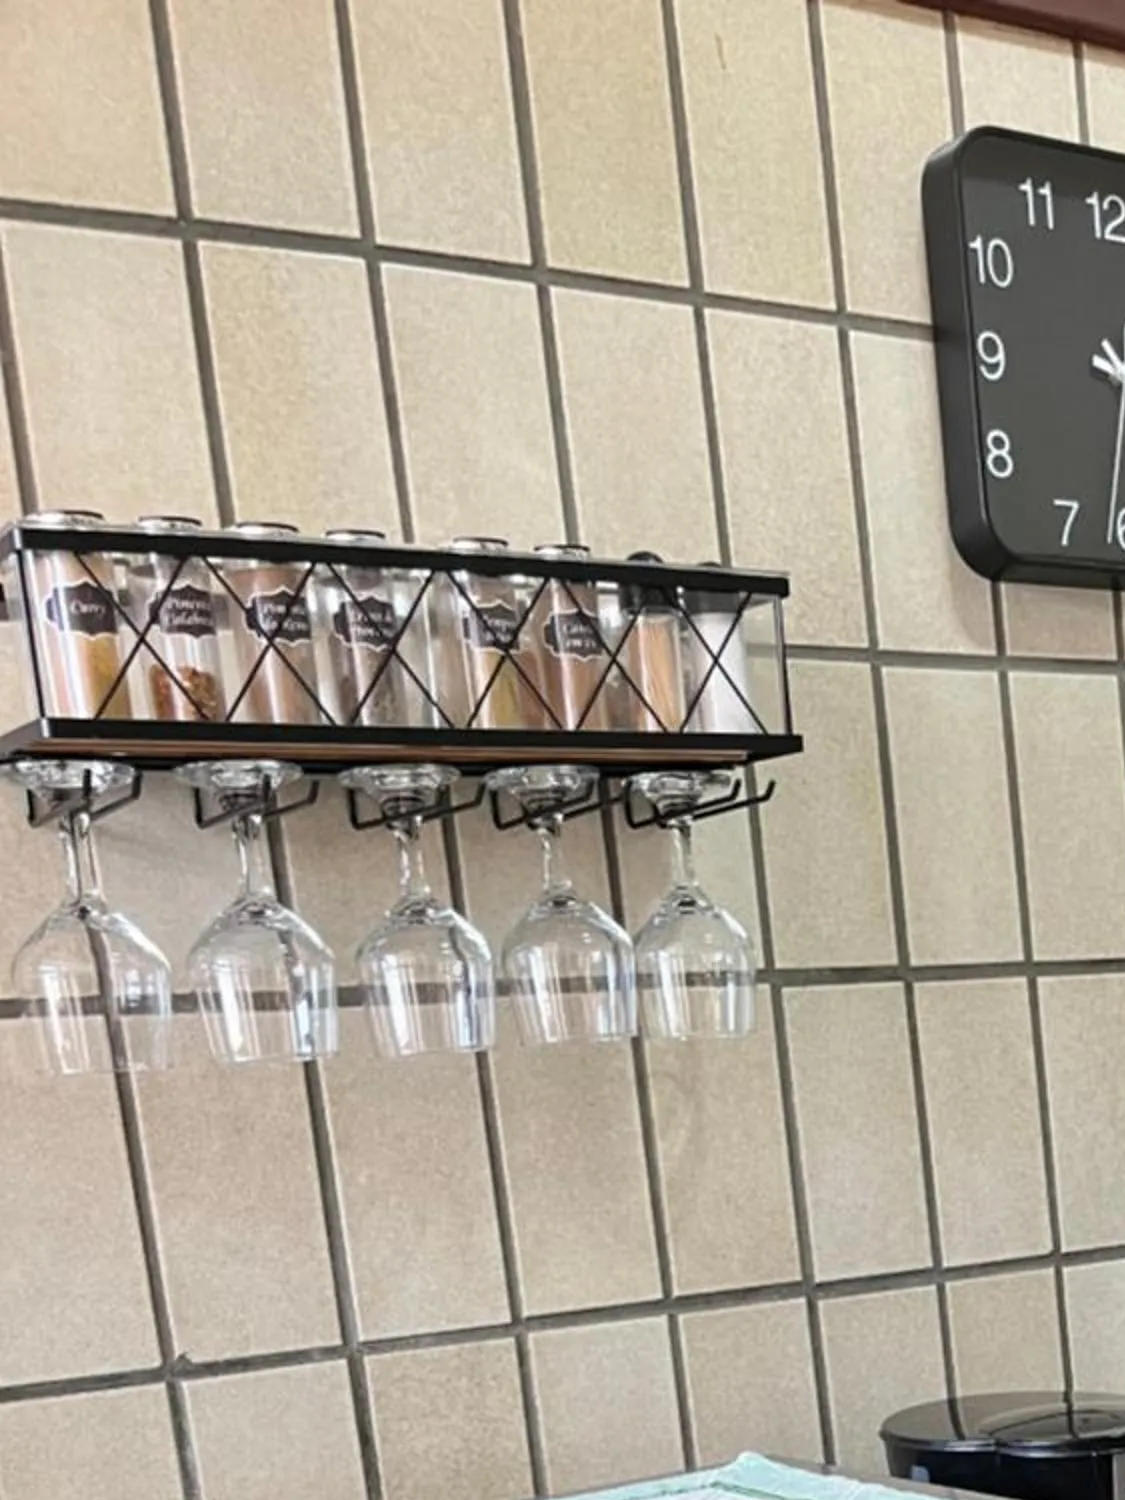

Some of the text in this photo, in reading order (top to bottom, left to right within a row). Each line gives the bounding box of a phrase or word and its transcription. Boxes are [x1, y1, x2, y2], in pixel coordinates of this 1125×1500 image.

[1018, 177, 1055, 230] 11
[968, 234, 1014, 288] 10
[976, 331, 1006, 381] 9
[985, 429, 1014, 479] 8
[1053, 499, 1080, 547] 7
